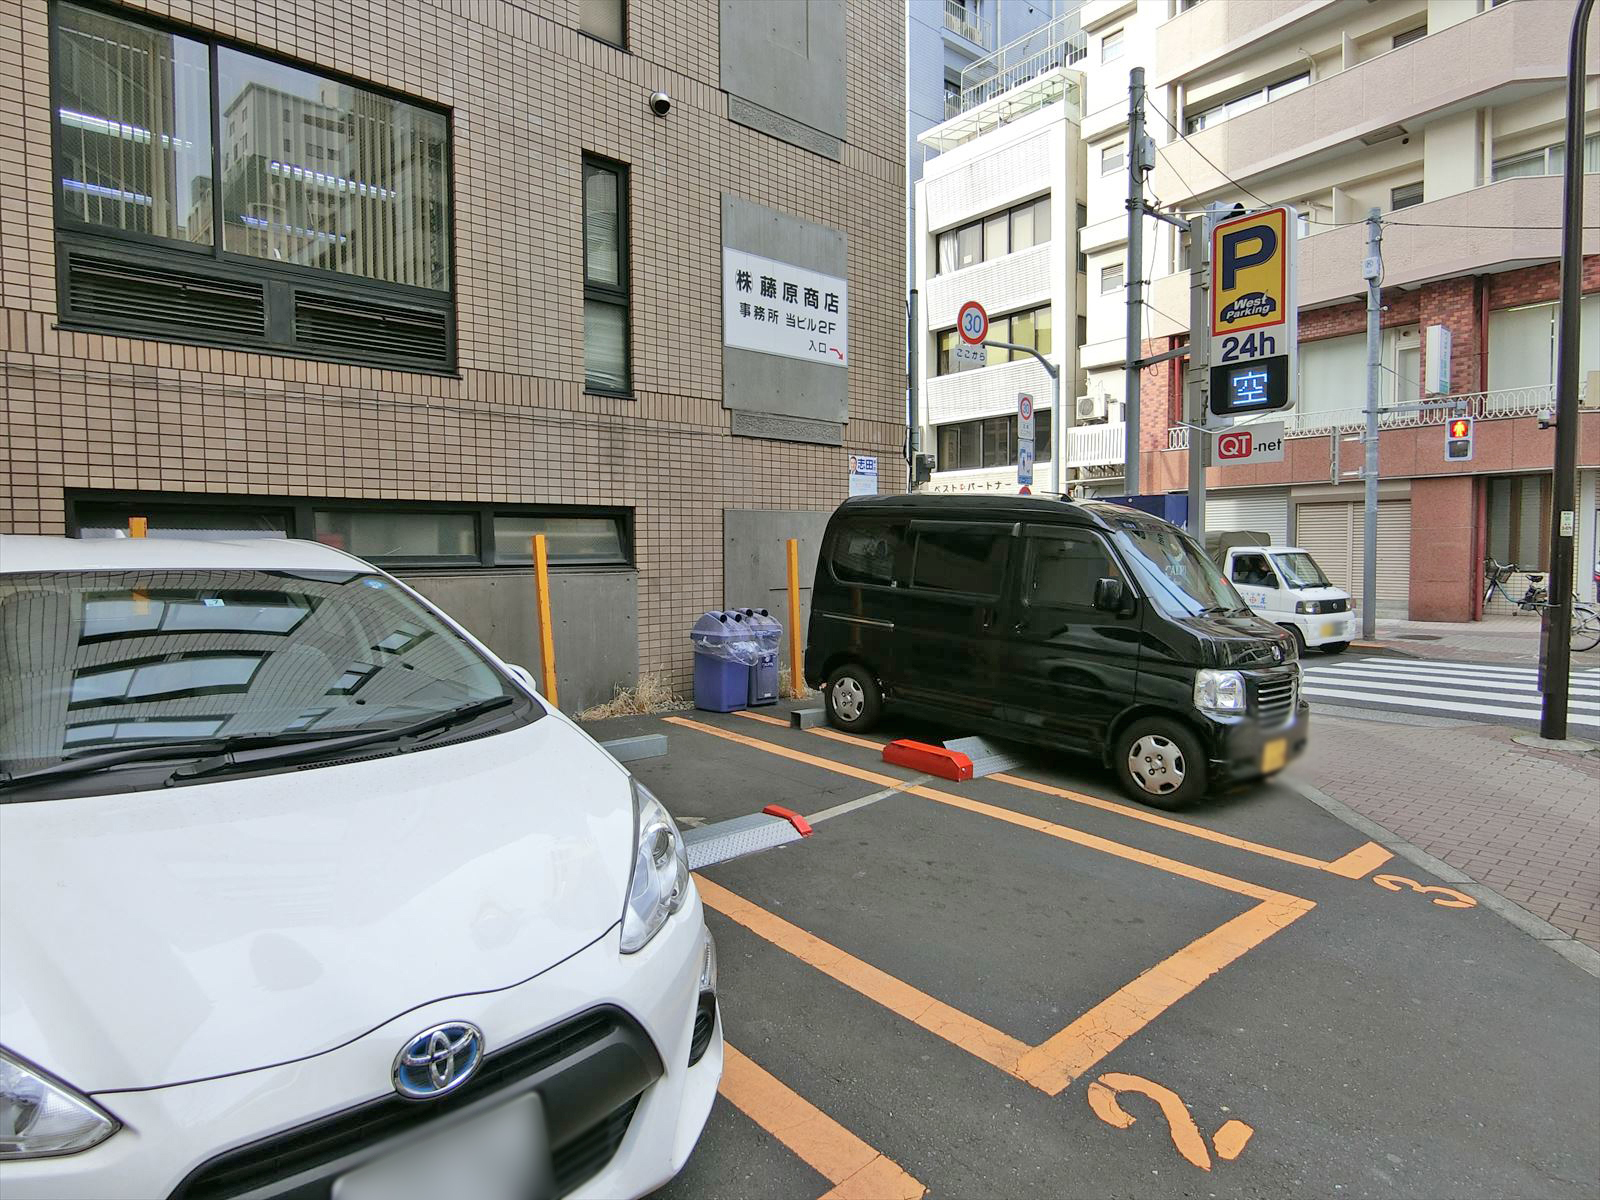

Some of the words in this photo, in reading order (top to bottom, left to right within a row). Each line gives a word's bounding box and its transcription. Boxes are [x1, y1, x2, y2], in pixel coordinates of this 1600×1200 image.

[1222, 225, 1278, 291] P
[1226, 304, 1270, 320] Parking
[1234, 290, 1268, 310] West
[740, 302, 779, 324] 事務所
[786, 313, 837, 335] 当ビル2F
[964, 313, 982, 333] 30
[808, 340, 827, 353] 入口
[956, 348, 985, 361] ここから
[1221, 331, 1276, 362] 24h
[1232, 371, 1268, 405] 空
[857, 458, 873, 470] 志田
[1373, 874, 1478, 908] 3
[1087, 1072, 1254, 1172] 2
